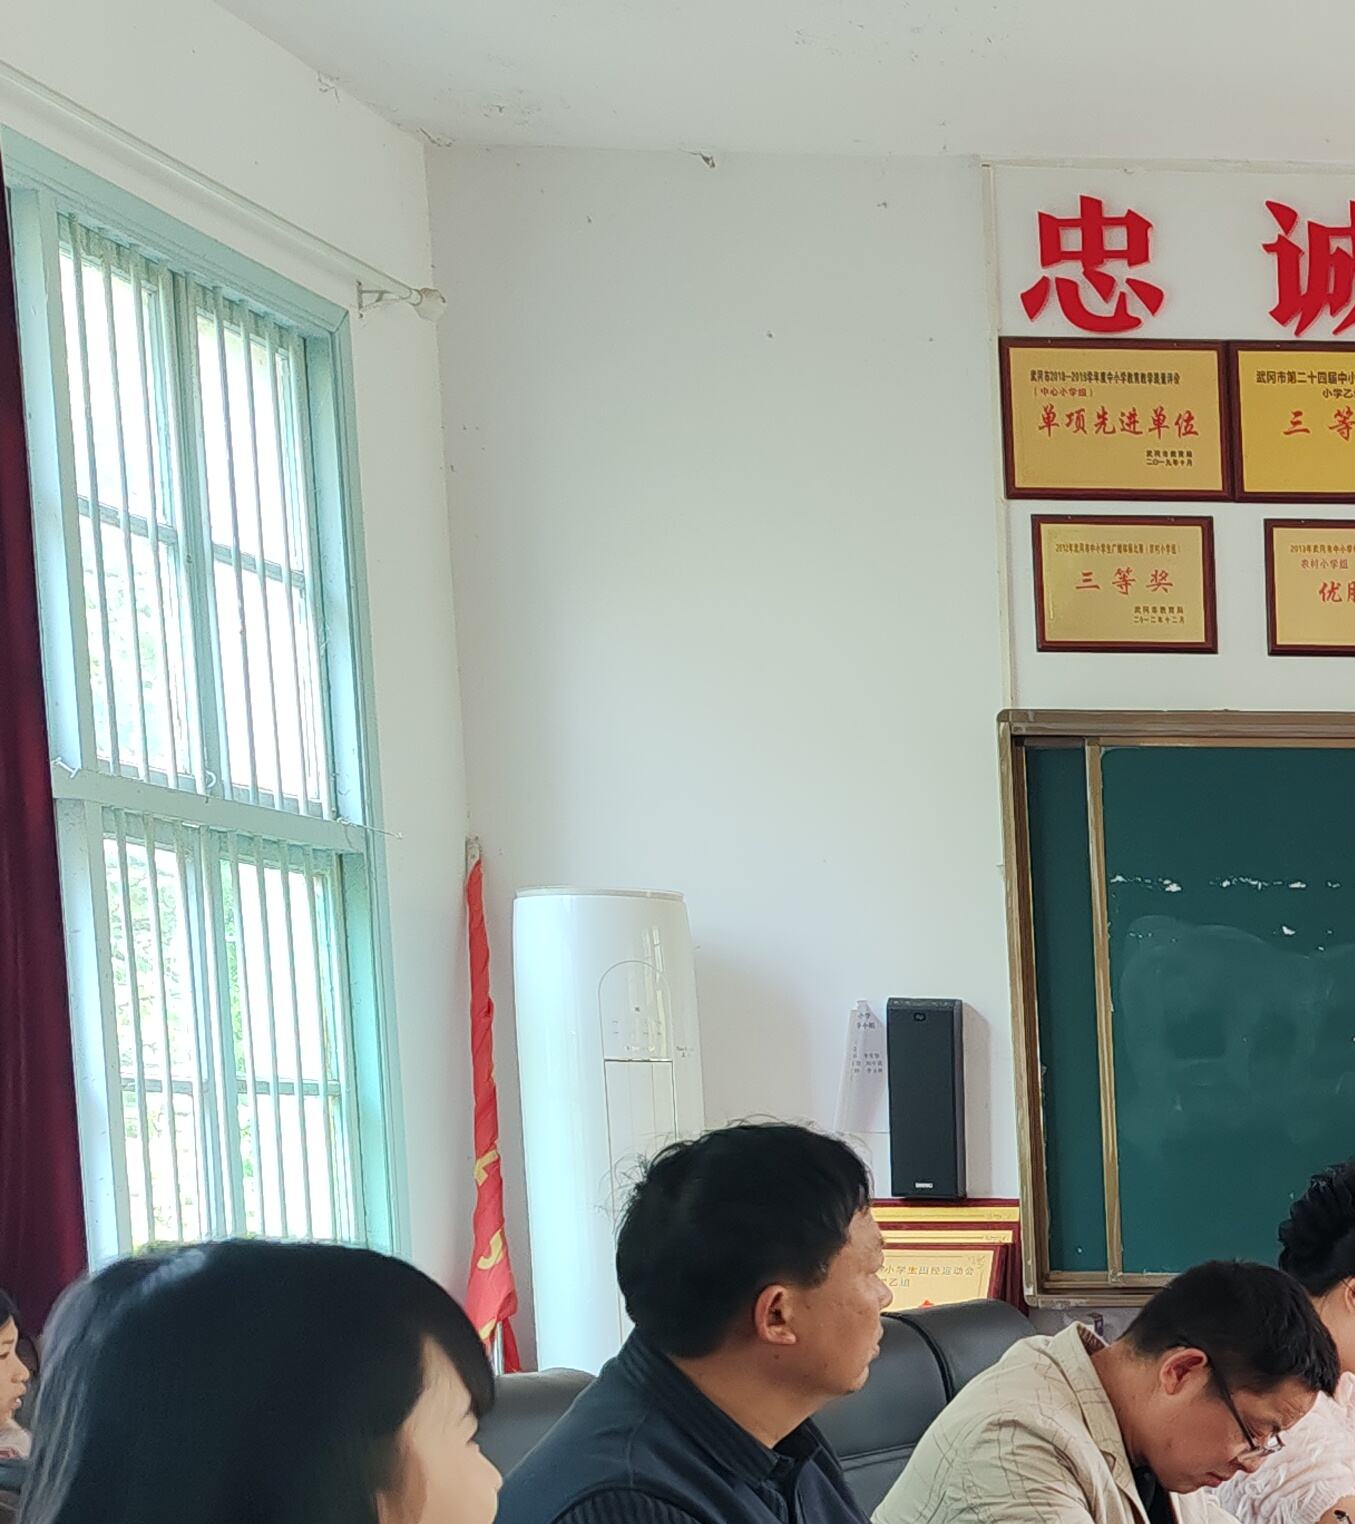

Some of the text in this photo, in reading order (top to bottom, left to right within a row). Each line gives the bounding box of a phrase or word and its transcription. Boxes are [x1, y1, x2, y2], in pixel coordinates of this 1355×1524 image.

[1038, 403, 1199, 439] 单项先进单位
[1301, 559, 1348, 569] 农村小学组
[1076, 567, 1174, 596] 三等奖
[884, 1277, 910, 1287] 乙组
